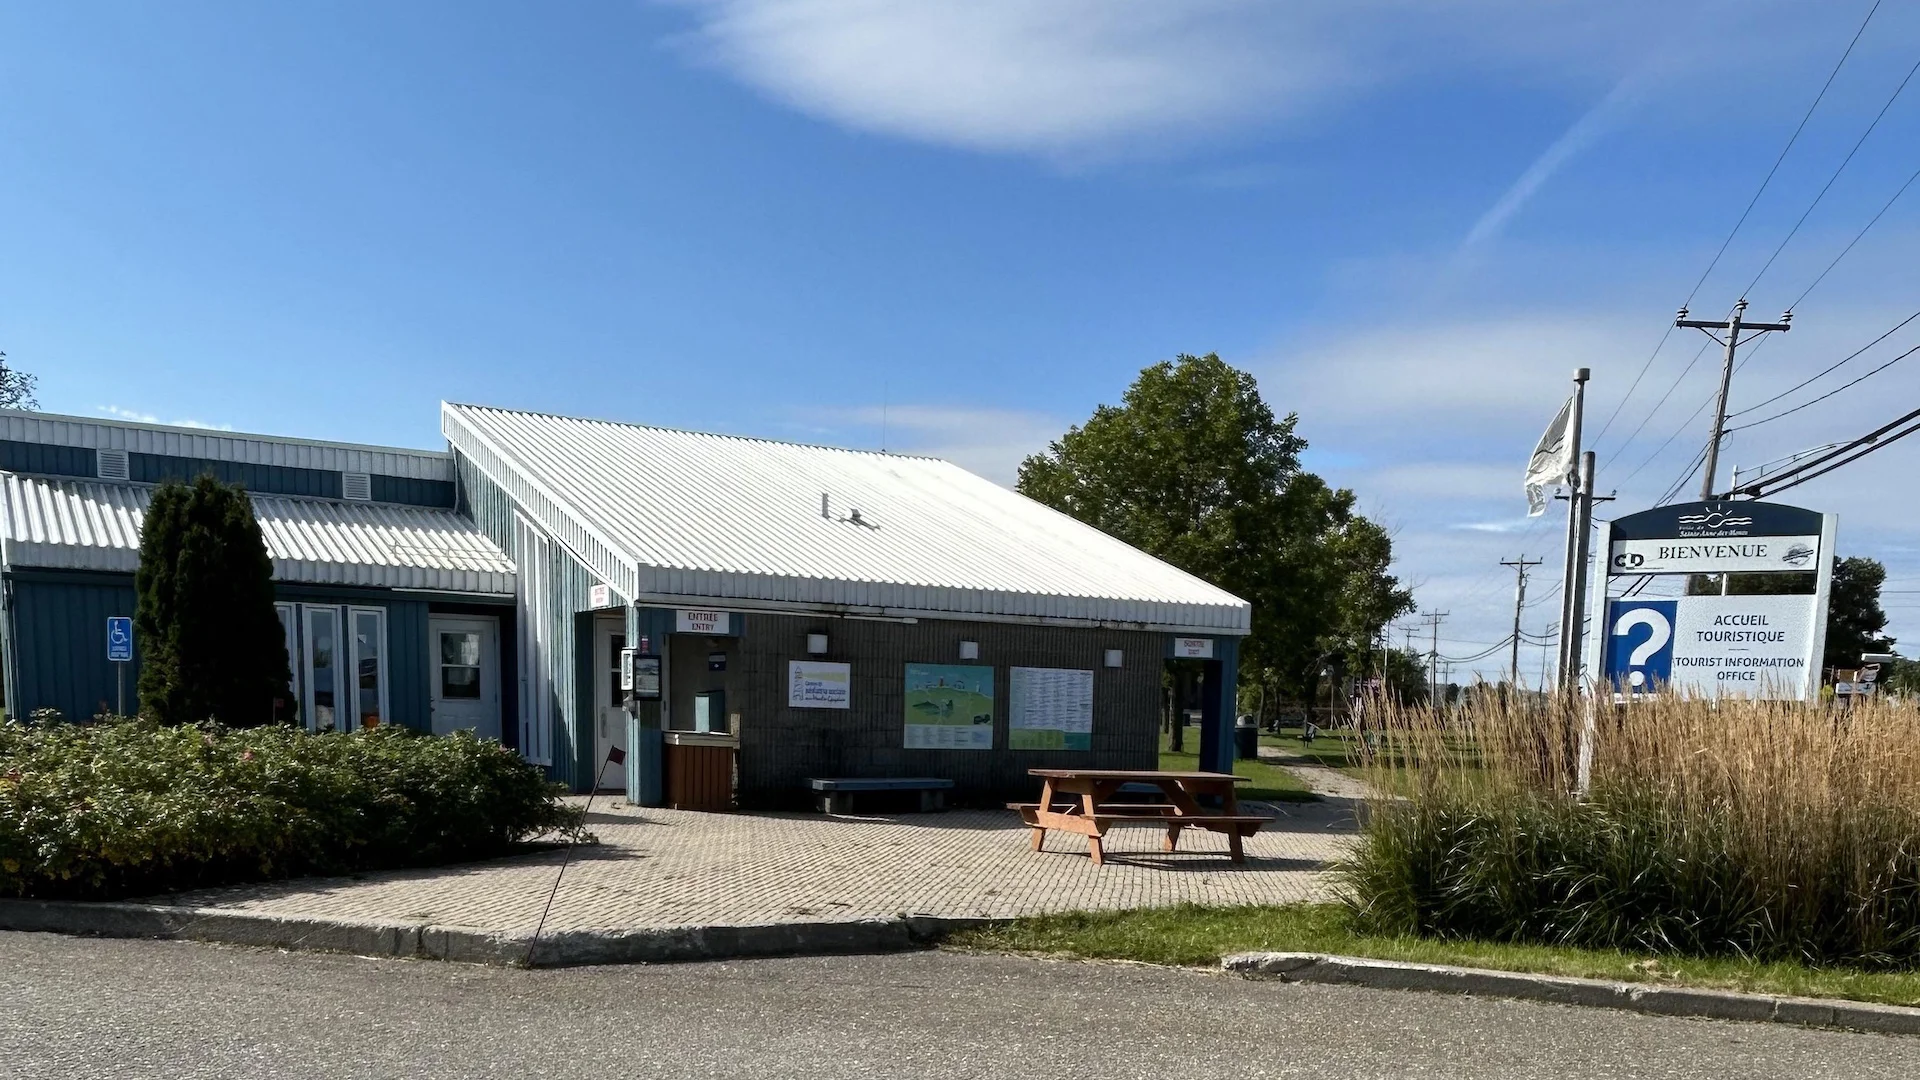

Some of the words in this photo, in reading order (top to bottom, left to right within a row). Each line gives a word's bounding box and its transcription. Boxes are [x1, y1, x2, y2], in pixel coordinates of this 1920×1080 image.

[1658, 544, 1769, 560] BIENVENUE
[687, 611, 719, 622] ENTRÉE
[1713, 614, 1770, 627] ACCUEIL
[691, 623, 715, 631] ENTRY
[1696, 630, 1786, 644] TOURISTIQUE
[1675, 656, 1723, 667] TOURIST
[1724, 656, 1805, 668] INFORMATION
[1716, 671, 1756, 682] OFFICE
